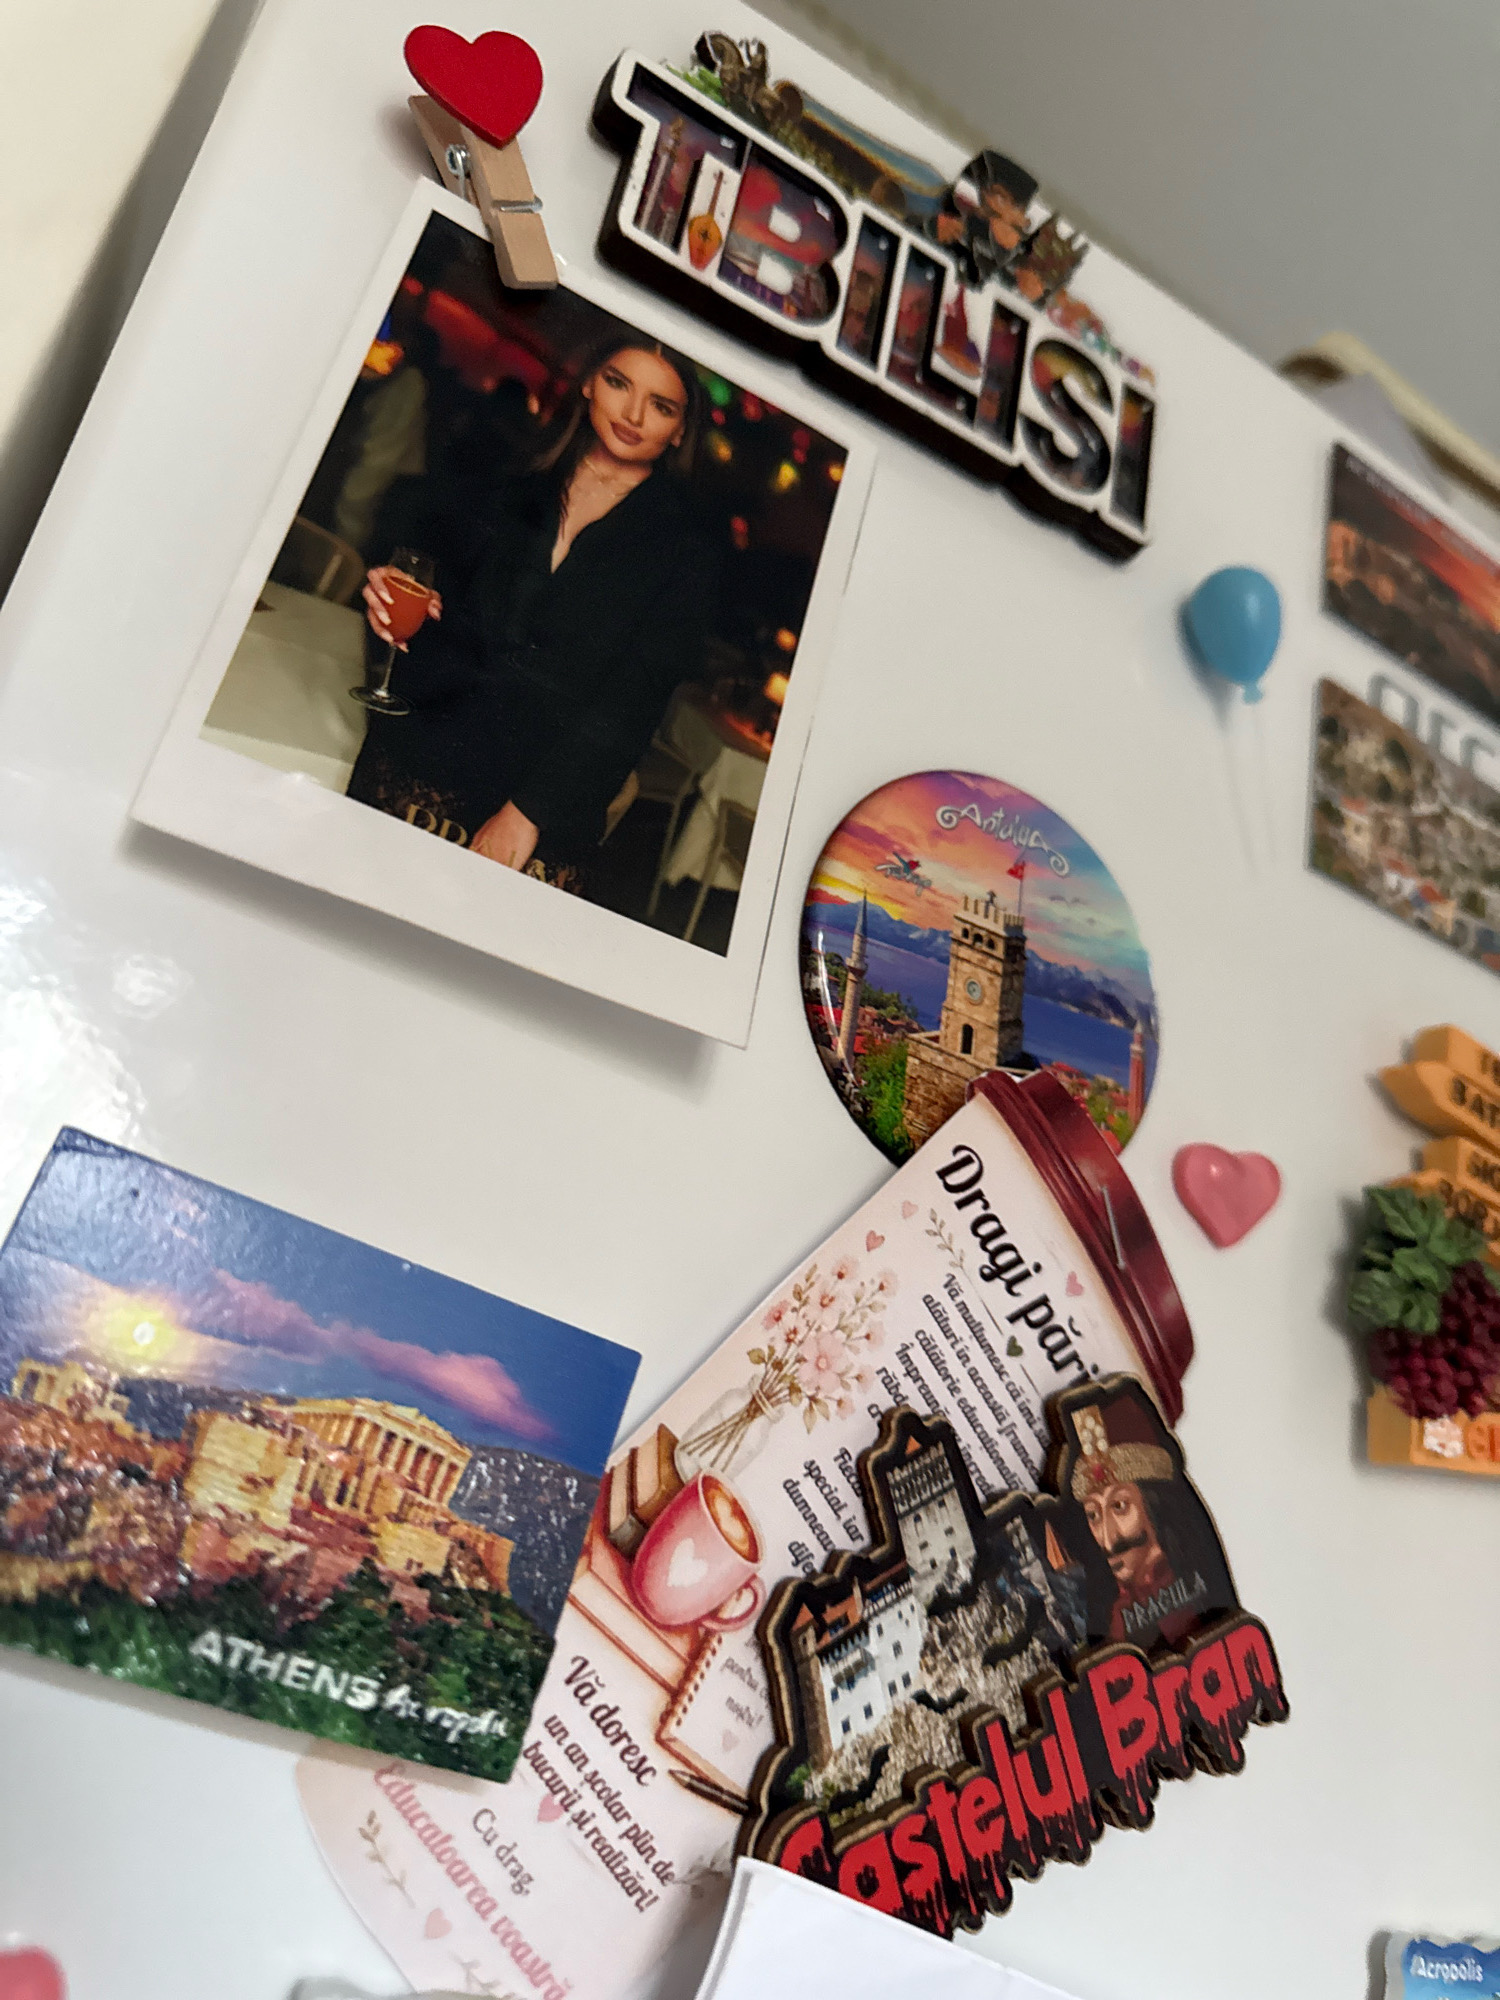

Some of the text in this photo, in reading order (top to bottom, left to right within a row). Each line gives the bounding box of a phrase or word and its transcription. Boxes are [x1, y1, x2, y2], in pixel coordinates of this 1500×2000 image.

[610, 48, 1157, 546] TBILISI
[936, 1144, 1099, 1386] Dragi pări
[876, 1367, 909, 1409] răbd
[915, 1330, 1026, 1494] călătorie educațională
[922, 1294, 963, 1349] alături
[956, 1345, 970, 1368] în
[967, 1367, 1010, 1426] această
[943, 1273, 963, 1301] Vă
[955, 1301, 1009, 1382] mulțumesc
[1005, 1381, 1025, 1402] că
[1017, 1399, 1044, 1429] îmi
[783, 1479, 836, 1554] dumneav
[788, 1541, 815, 1578] dife
[843, 1516, 865, 1543] iar
[189, 1629, 381, 1710] ATHENS
[1122, 1578, 1207, 1633] DRACULA
[565, 1656, 656, 1786] Vă doresc
[1087, 1623, 1287, 1817] Bran
[472, 1808, 534, 1895] Cu drag,
[519, 1741, 582, 1812] bucurii
[584, 1827, 659, 1913] realizări!
[544, 1715, 675, 1886] un an școlar plin de
[374, 1760, 572, 2000] Educatoarea voastră
